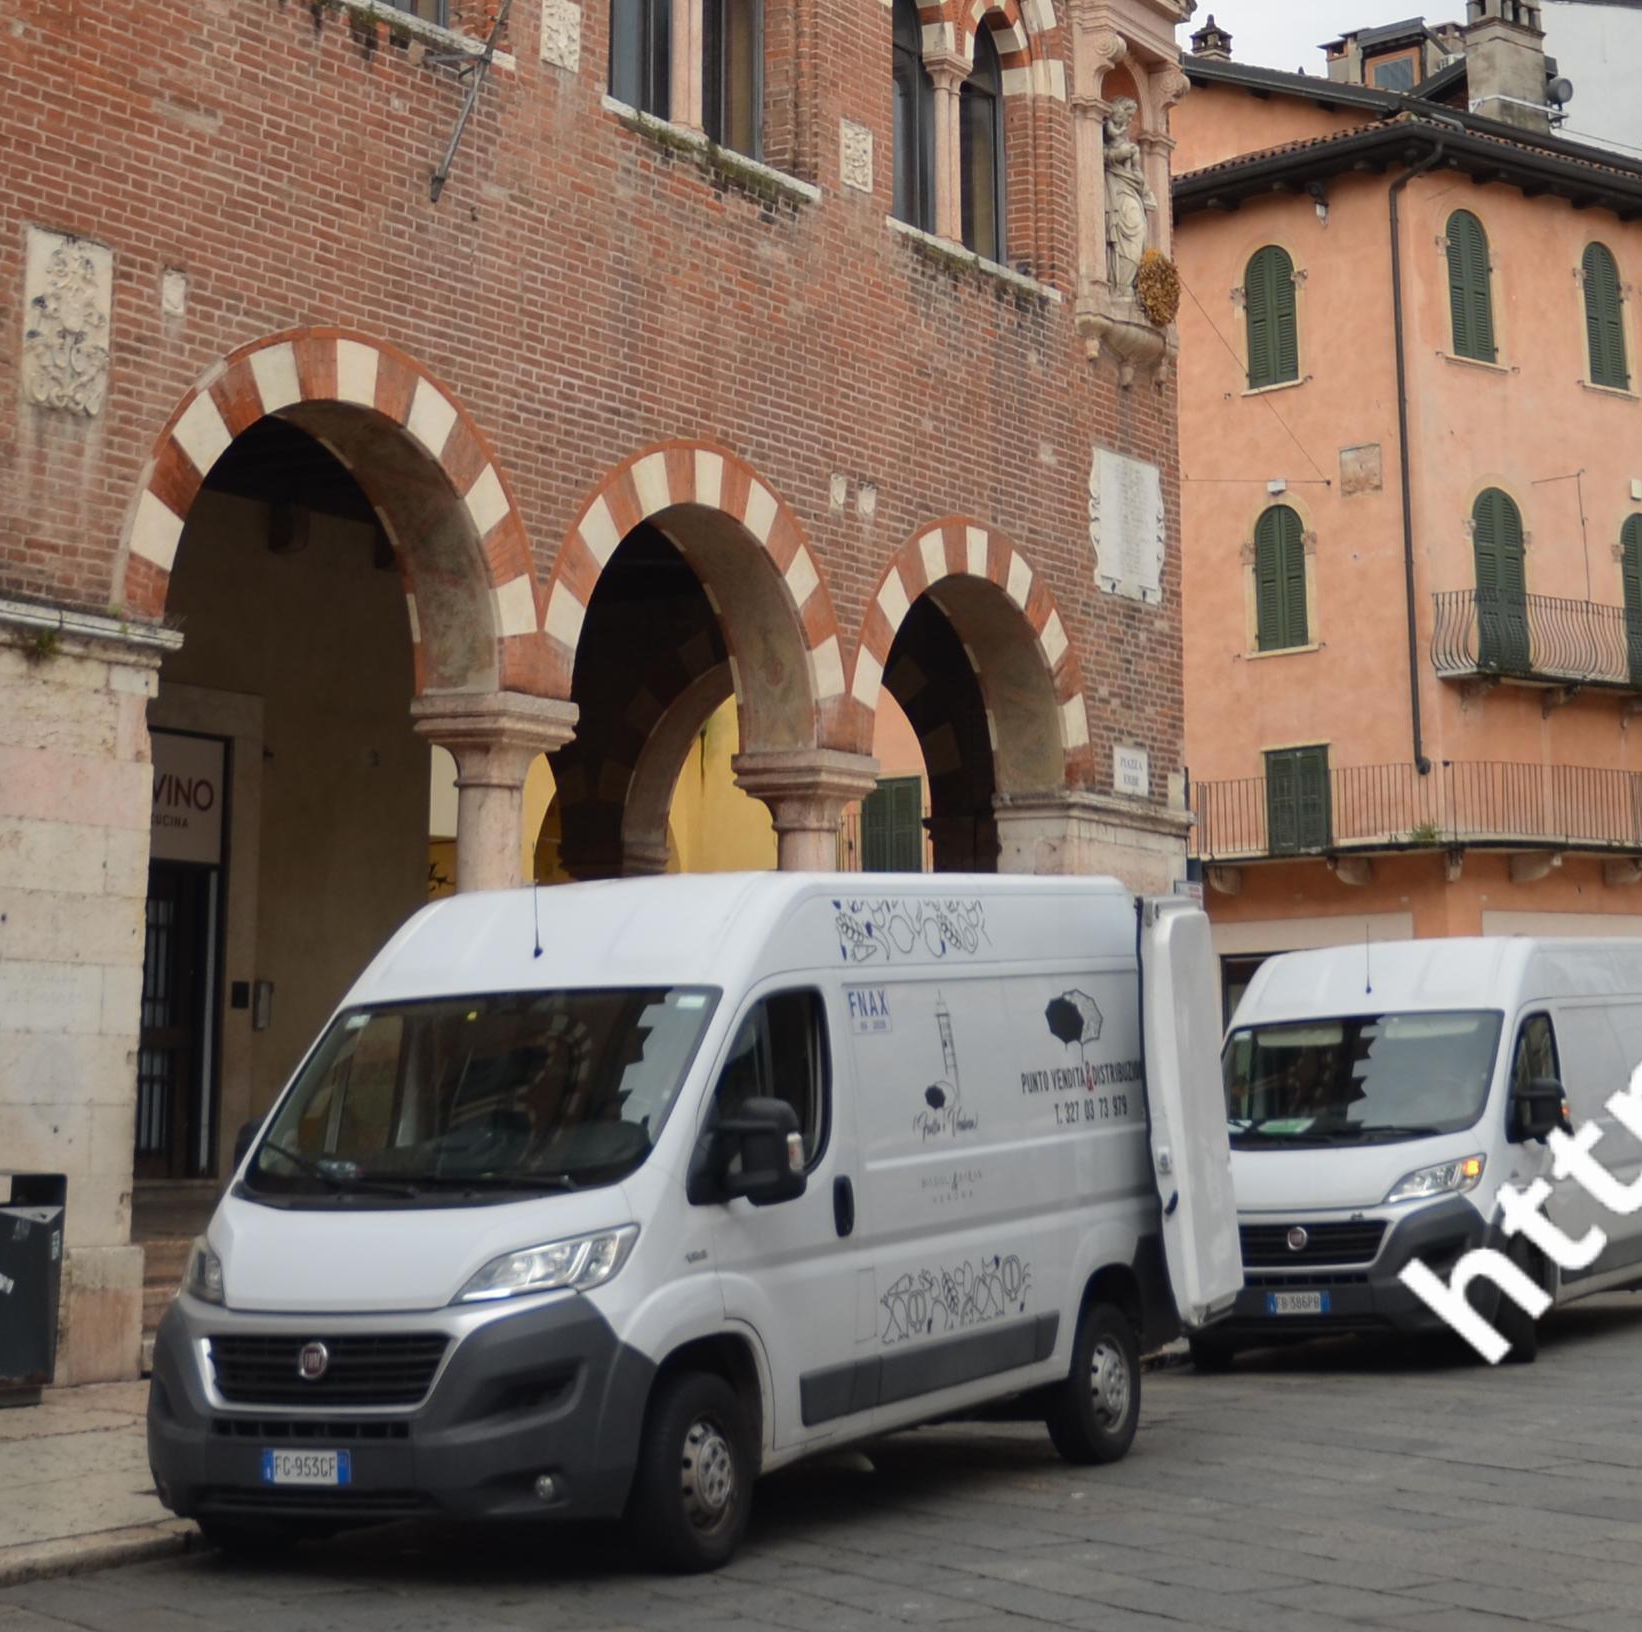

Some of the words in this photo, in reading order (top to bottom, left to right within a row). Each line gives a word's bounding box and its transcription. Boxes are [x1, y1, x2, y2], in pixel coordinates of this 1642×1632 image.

[848, 990, 889, 1018] FNAX
[1021, 1071, 1049, 1094] PUNTO
[1112, 1094, 1127, 1117] 979
